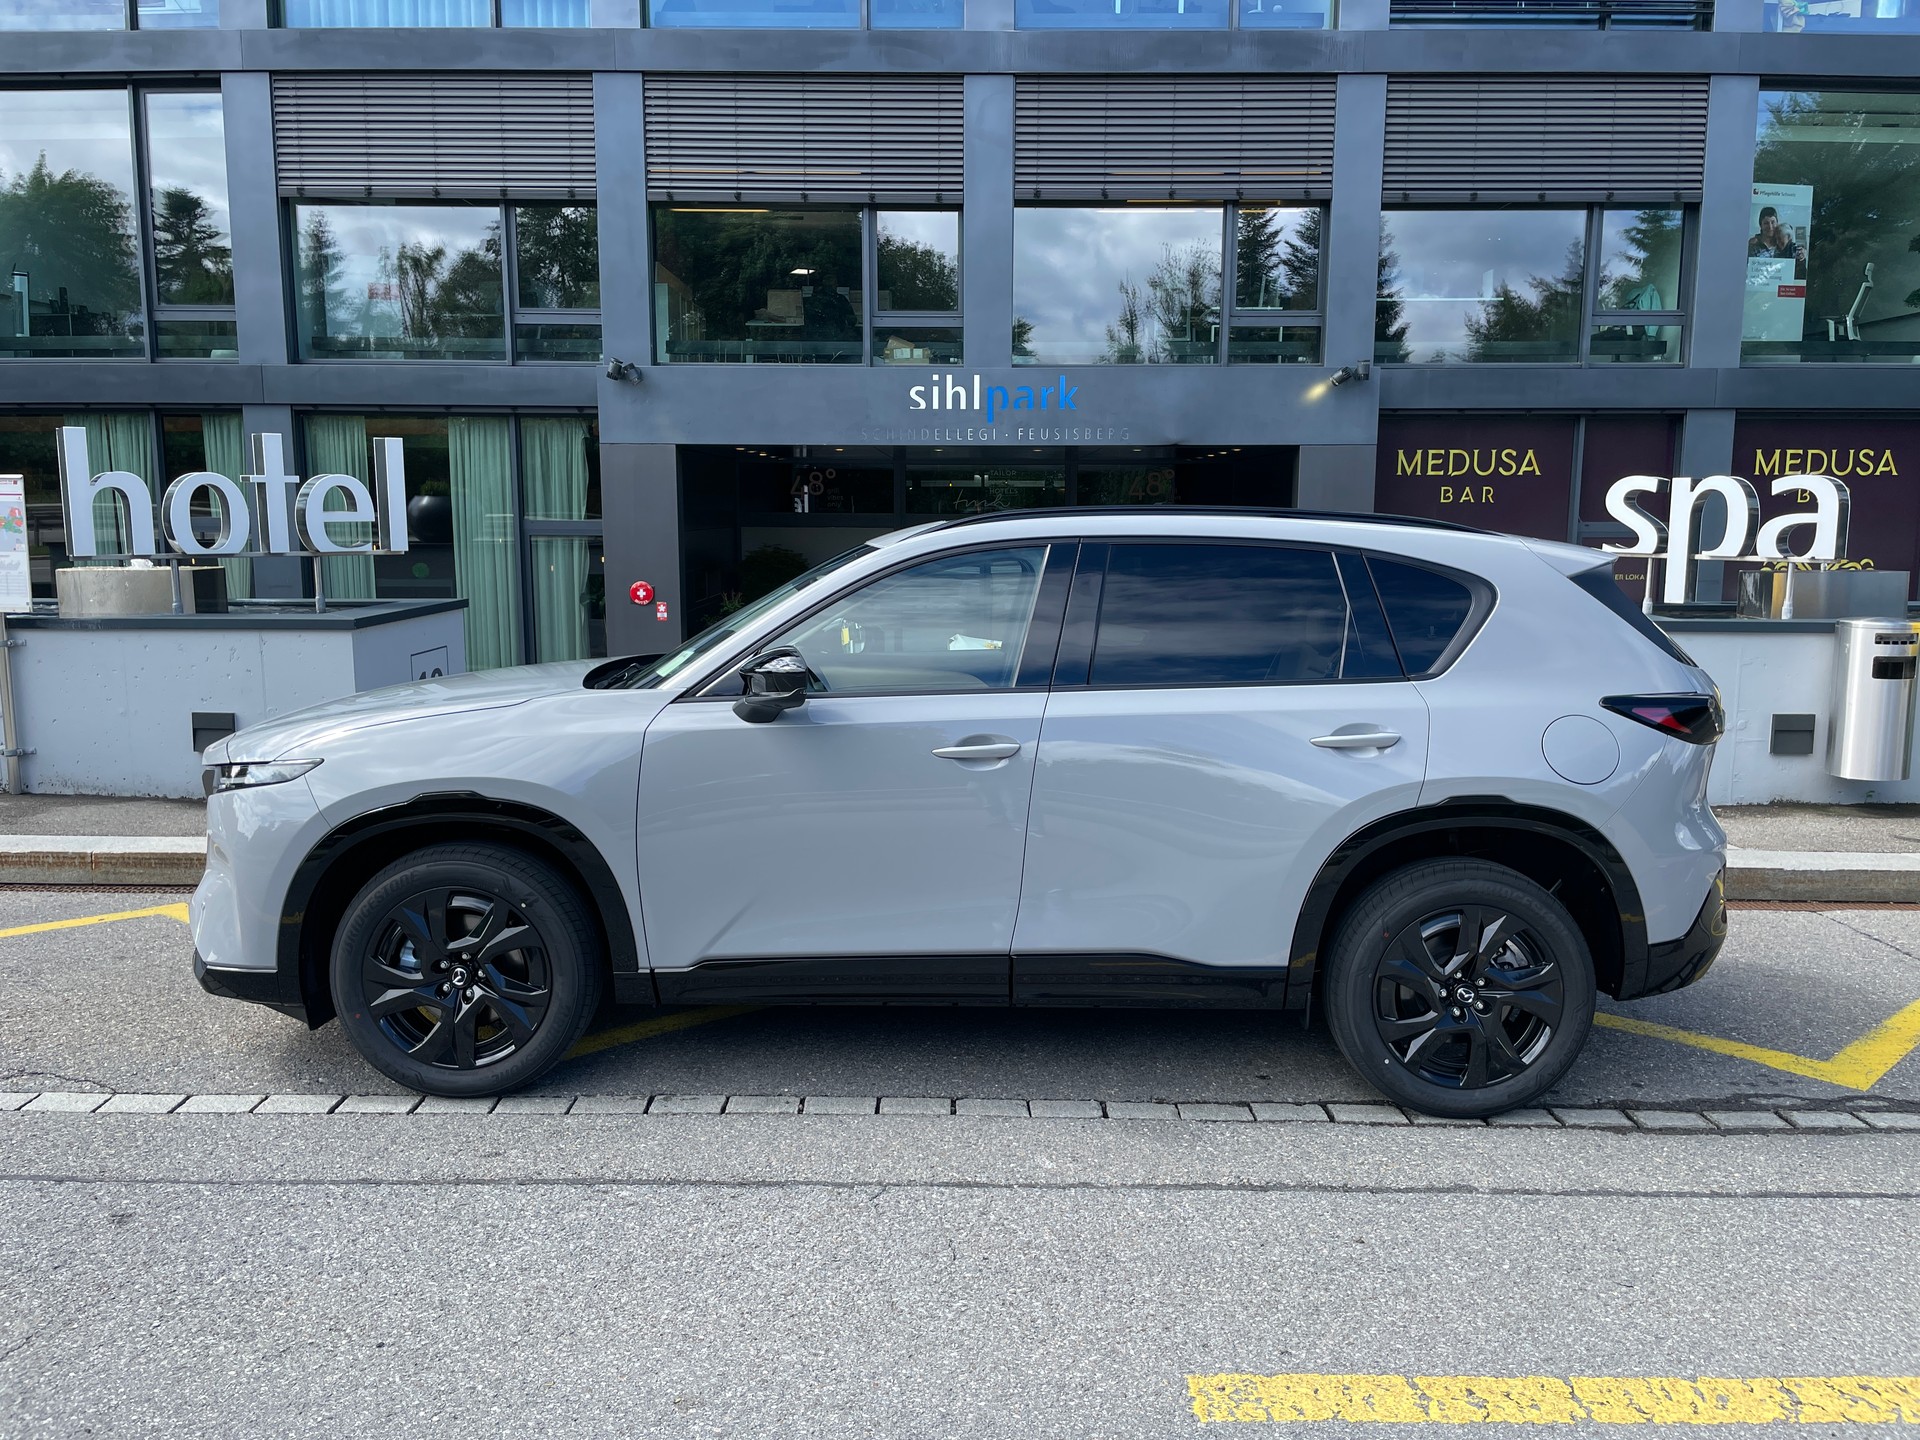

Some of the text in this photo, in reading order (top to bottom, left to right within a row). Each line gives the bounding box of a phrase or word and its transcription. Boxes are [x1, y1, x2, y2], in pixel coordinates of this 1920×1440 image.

[909, 374, 1079, 424] sihlpark
[861, 427, 1130, 441] SCHINDELLEGI FEUSISBERG
[1396, 448, 1542, 477] MEDUSA
[1753, 448, 1899, 477] MEDUSA
[56, 426, 409, 557] hotel
[1440, 486, 1494, 503] BAR
[1602, 474, 1851, 604] spa
